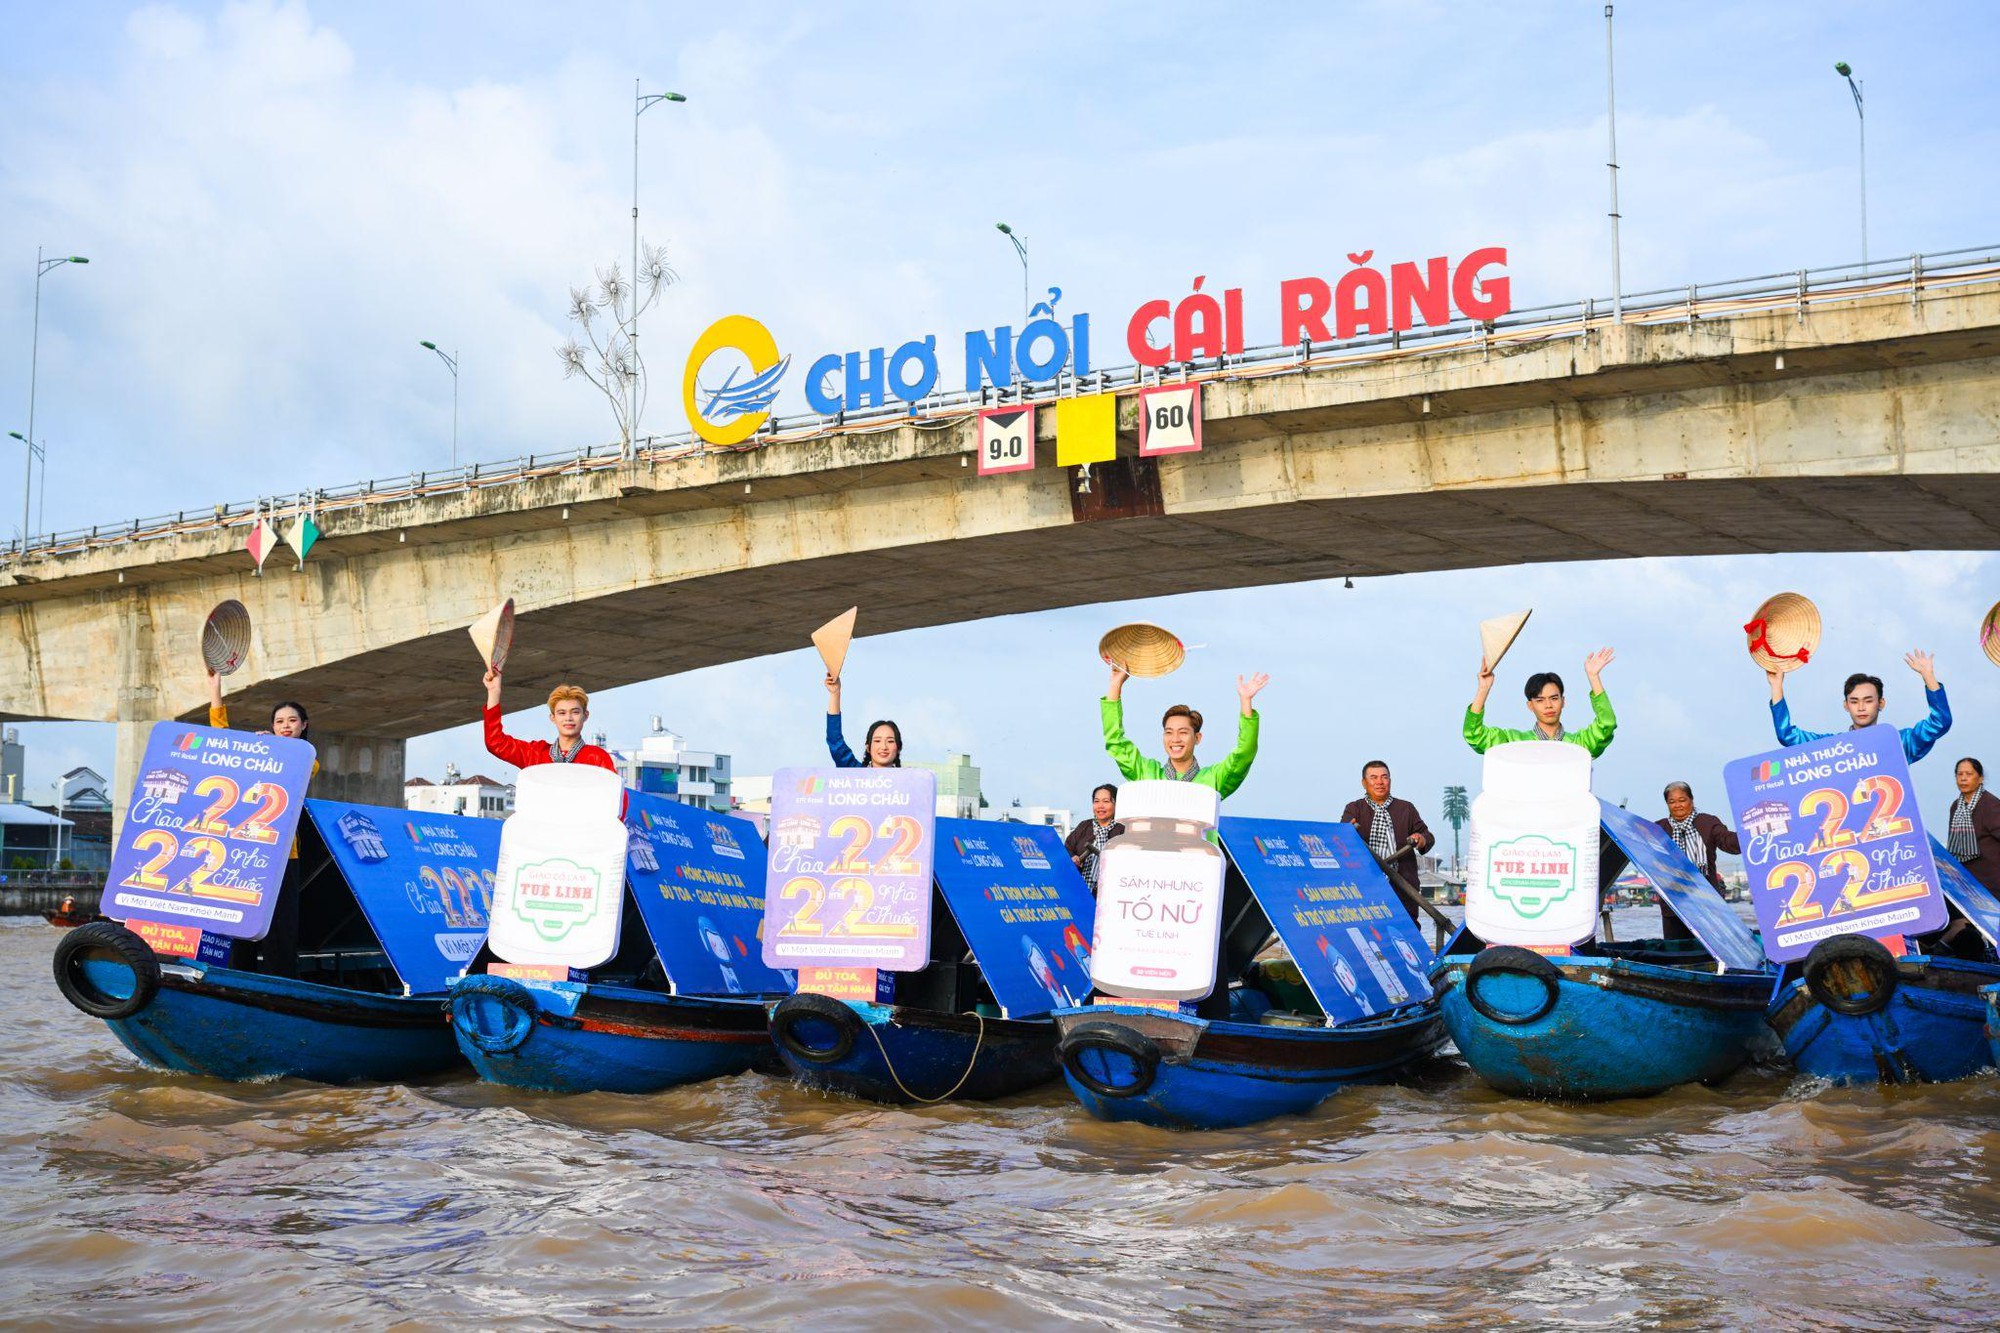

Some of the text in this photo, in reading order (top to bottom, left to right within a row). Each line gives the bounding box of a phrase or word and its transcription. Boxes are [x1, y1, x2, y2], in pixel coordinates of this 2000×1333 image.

[805, 246, 1512, 417] CHỢ NỔI CÁI RĂNG
[1155, 404, 1185, 430] 60
[989, 435, 1022, 460] 9.0
[206, 737, 270, 755] NHÀ THUỐC
[170, 751, 182, 759] FPT
[201, 752, 284, 774] LONG CHÂU
[1784, 741, 1855, 769] NHÀ THUỐC
[1788, 753, 1878, 786] LONG CHÂU
[828, 775, 894, 789] NHÀ THUỐC
[1754, 780, 1784, 792] FPT Retail
[828, 790, 910, 806] LONG CHÂU
[131, 796, 184, 829] Chào
[420, 824, 459, 839] NHÀ THUỐC
[658, 830, 679, 846] LONG
[430, 842, 455, 857] LONG
[454, 842, 478, 858] CHÂU
[1747, 832, 1808, 865] Chào
[772, 845, 825, 873] Chào
[1494, 860, 1569, 876] TUỆ LINH
[212, 868, 267, 892] Thuốc
[1119, 874, 1204, 892] SÂM NHUNG
[1867, 865, 1925, 892] Thuốc
[520, 883, 594, 899] TUỆ LINH
[167, 902, 188, 913] Nam
[1117, 894, 1203, 924] TỐ NỮ
[141, 923, 185, 941] ĐỦ TOA,
[1157, 930, 1179, 939] LINH
[1836, 922, 1859, 935] Nam
[172, 941, 195, 954] NHÀ
[815, 968, 832, 980] ĐỦ
[800, 982, 872, 994] GIAO TẬN NHÀ
